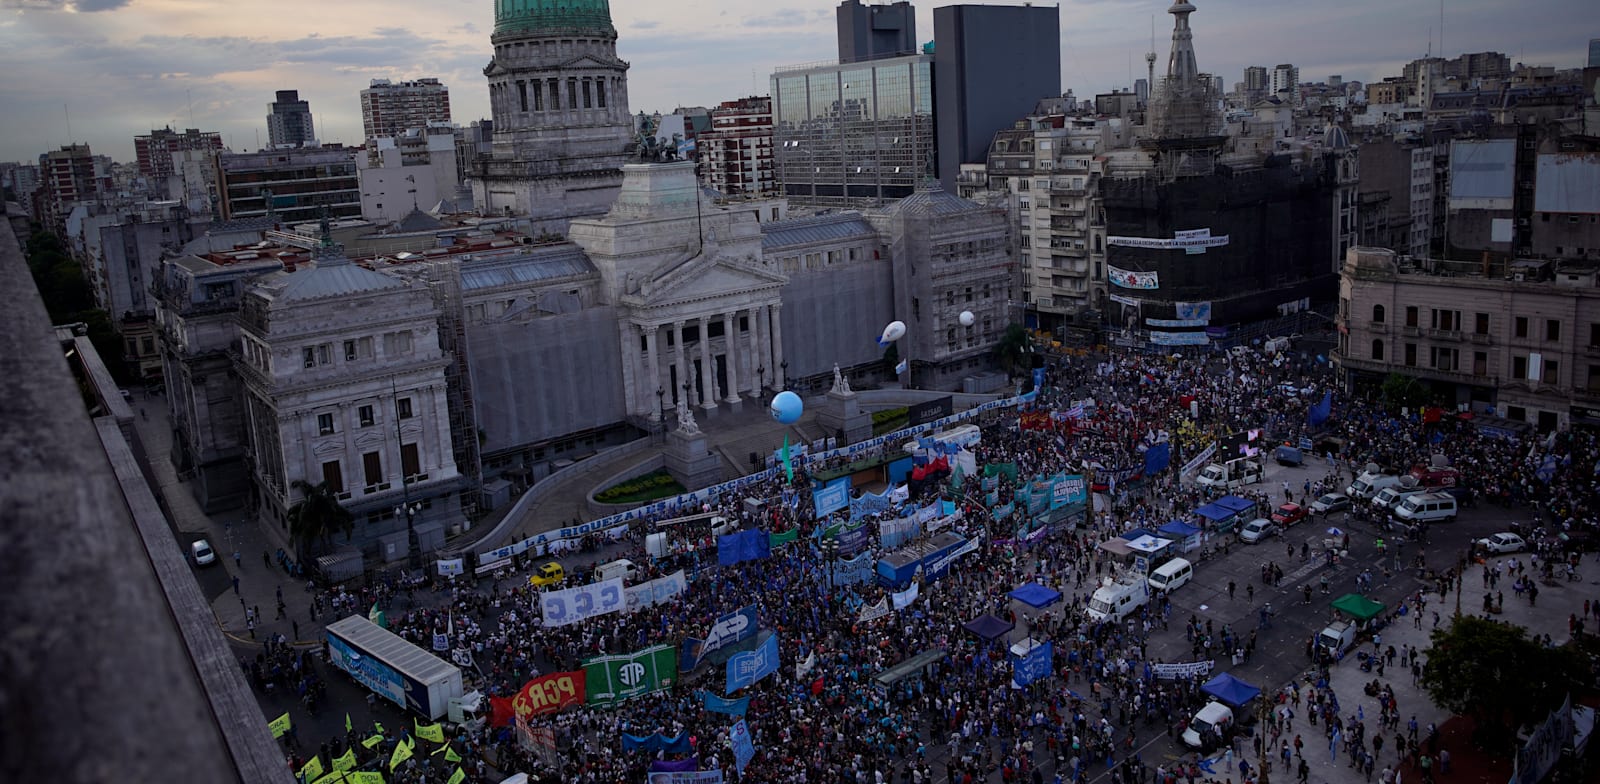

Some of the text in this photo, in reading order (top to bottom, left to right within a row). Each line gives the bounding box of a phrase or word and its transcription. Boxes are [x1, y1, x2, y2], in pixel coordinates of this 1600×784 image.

[525, 534, 548, 548] LA
[560, 512, 634, 538] RIQUEZA
[677, 493, 698, 507] LA
[823, 449, 840, 459] LA
[958, 411, 971, 421] LA
